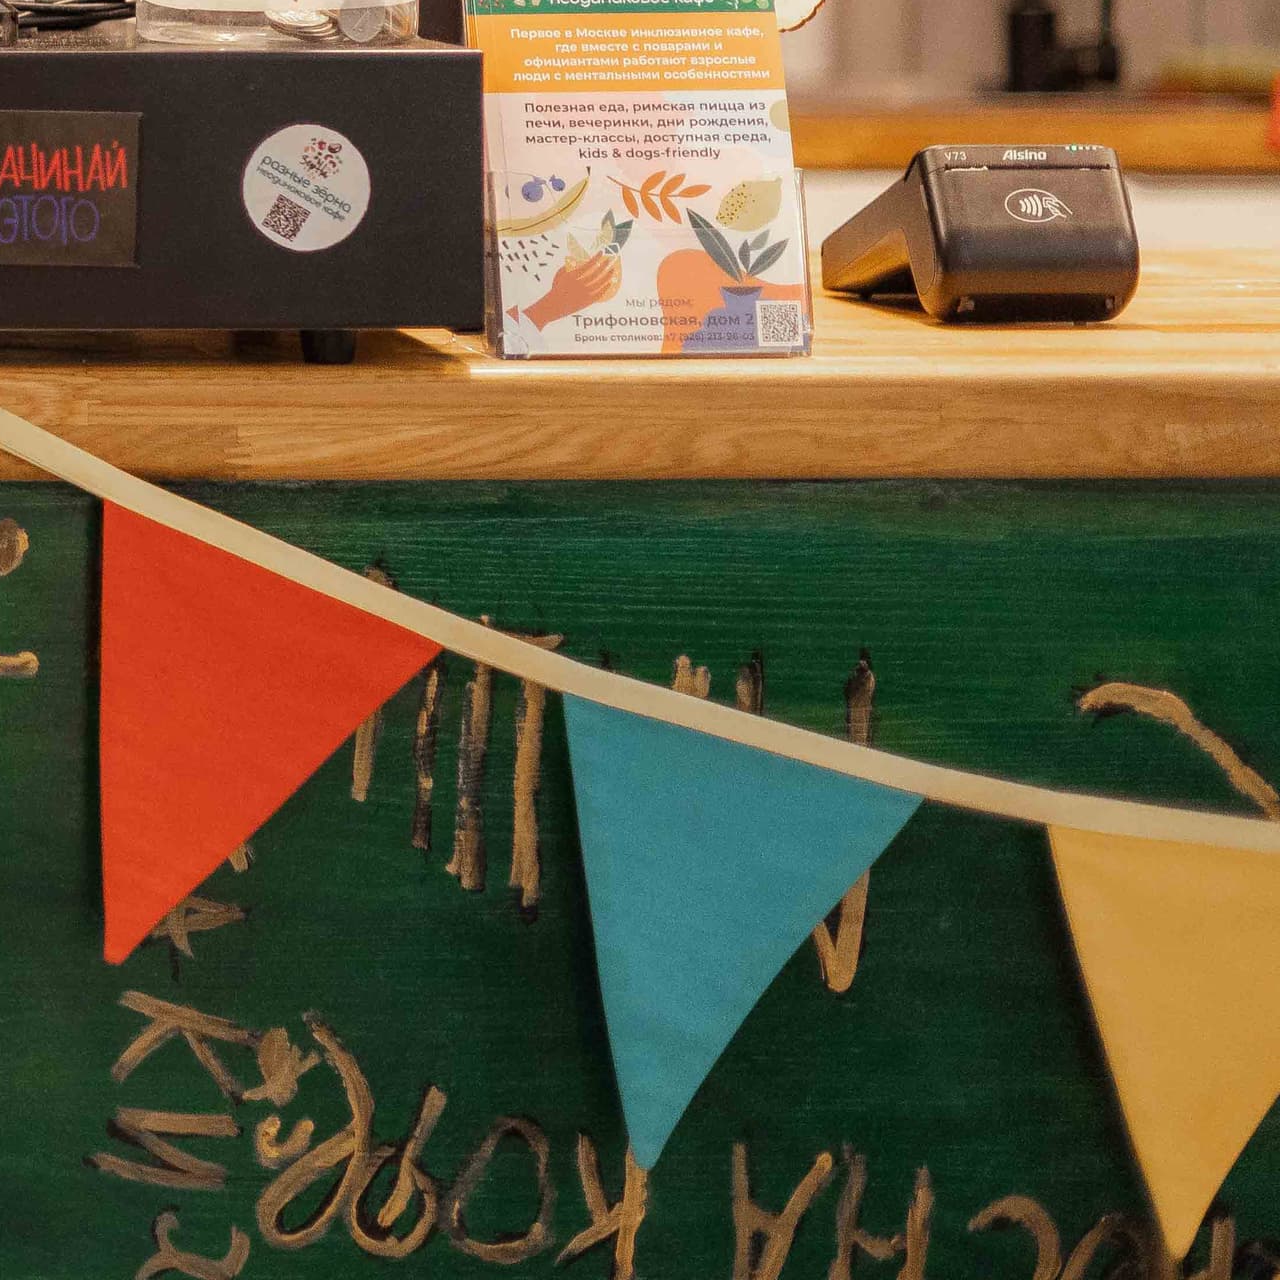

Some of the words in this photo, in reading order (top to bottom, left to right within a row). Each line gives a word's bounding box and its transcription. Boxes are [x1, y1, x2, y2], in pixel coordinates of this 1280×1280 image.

[510, 27, 561, 40] Первое
[565, 29, 573, 39] в
[576, 27, 627, 39] Москве
[631, 26, 723, 38] инклюзивное
[726, 25, 765, 39] кафе,
[555, 41, 579, 54] где
[581, 42, 629, 53] вместе
[632, 42, 640, 52] с
[643, 41, 710, 53] поварами
[714, 41, 723, 51] и
[524, 55, 619, 69] официантами
[623, 54, 687, 68] работают
[690, 54, 756, 66] взрослые
[513, 71, 551, 82] люди
[554, 71, 561, 81] с
[565, 70, 660, 81] ментальными
[664, 68, 770, 80] особенностями
[524, 102, 595, 113] Полезная
[598, 103, 629, 114] еда,
[633, 102, 695, 115] римская
[699, 102, 745, 112] пицца
[749, 102, 766, 111] из
[525, 119, 565, 130] печи,
[569, 118, 653, 130] вечеринки,
[657, 117, 685, 128] дни
[689, 116, 769, 129] рождения,
[525, 133, 640, 146] мастер-классы,
[643, 132, 720, 145] доступная
[724, 131, 772, 144] среда,
[578, 147, 608, 159] kids
[612, 148, 622, 158] &
[625, 146, 721, 161] dogs-friendly
[259, 154, 310, 189] разные
[311, 185, 352, 214] зёрна
[625, 298, 645, 308] мы
[572, 313, 702, 329] Трифоновская,
[706, 315, 740, 328] дом
[574, 333, 608, 343] Бронь
